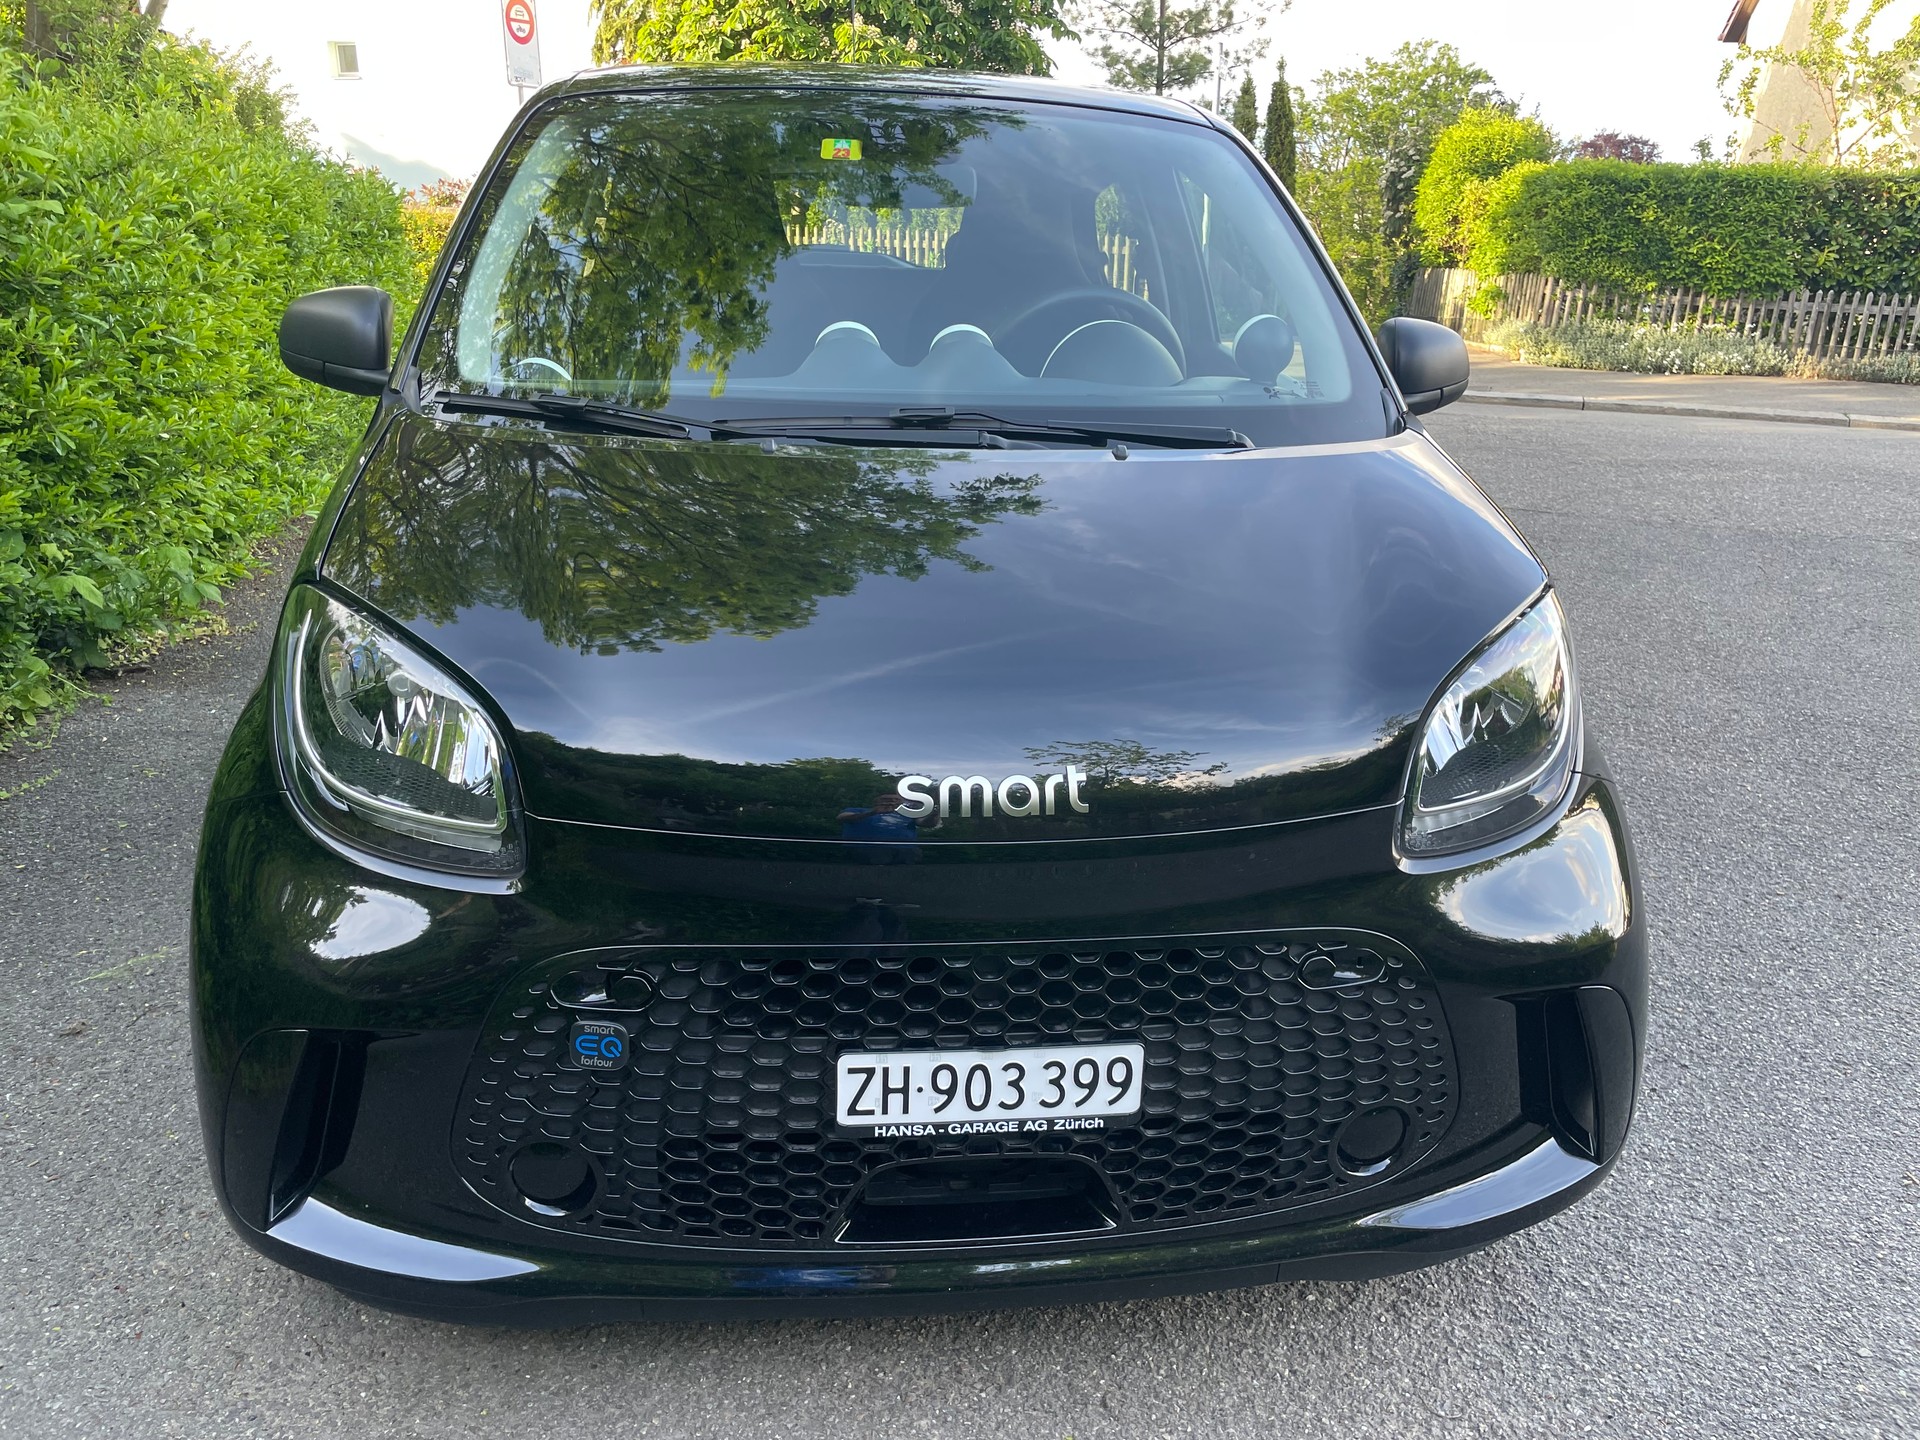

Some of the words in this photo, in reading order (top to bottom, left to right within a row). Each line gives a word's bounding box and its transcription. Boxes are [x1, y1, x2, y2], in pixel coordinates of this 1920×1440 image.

[832, 148, 851, 158] 23
[894, 765, 1090, 818] smart
[584, 1025, 615, 1035] smart
[575, 1034, 622, 1058] EQ
[581, 1055, 613, 1067] forfour
[1039, 1056, 1133, 1109] 399
[874, 1125, 936, 1137] HANSA
[947, 1121, 1019, 1134] GARAGE
[1022, 1120, 1048, 1132] AG
[1053, 1118, 1104, 1130] Zürich
